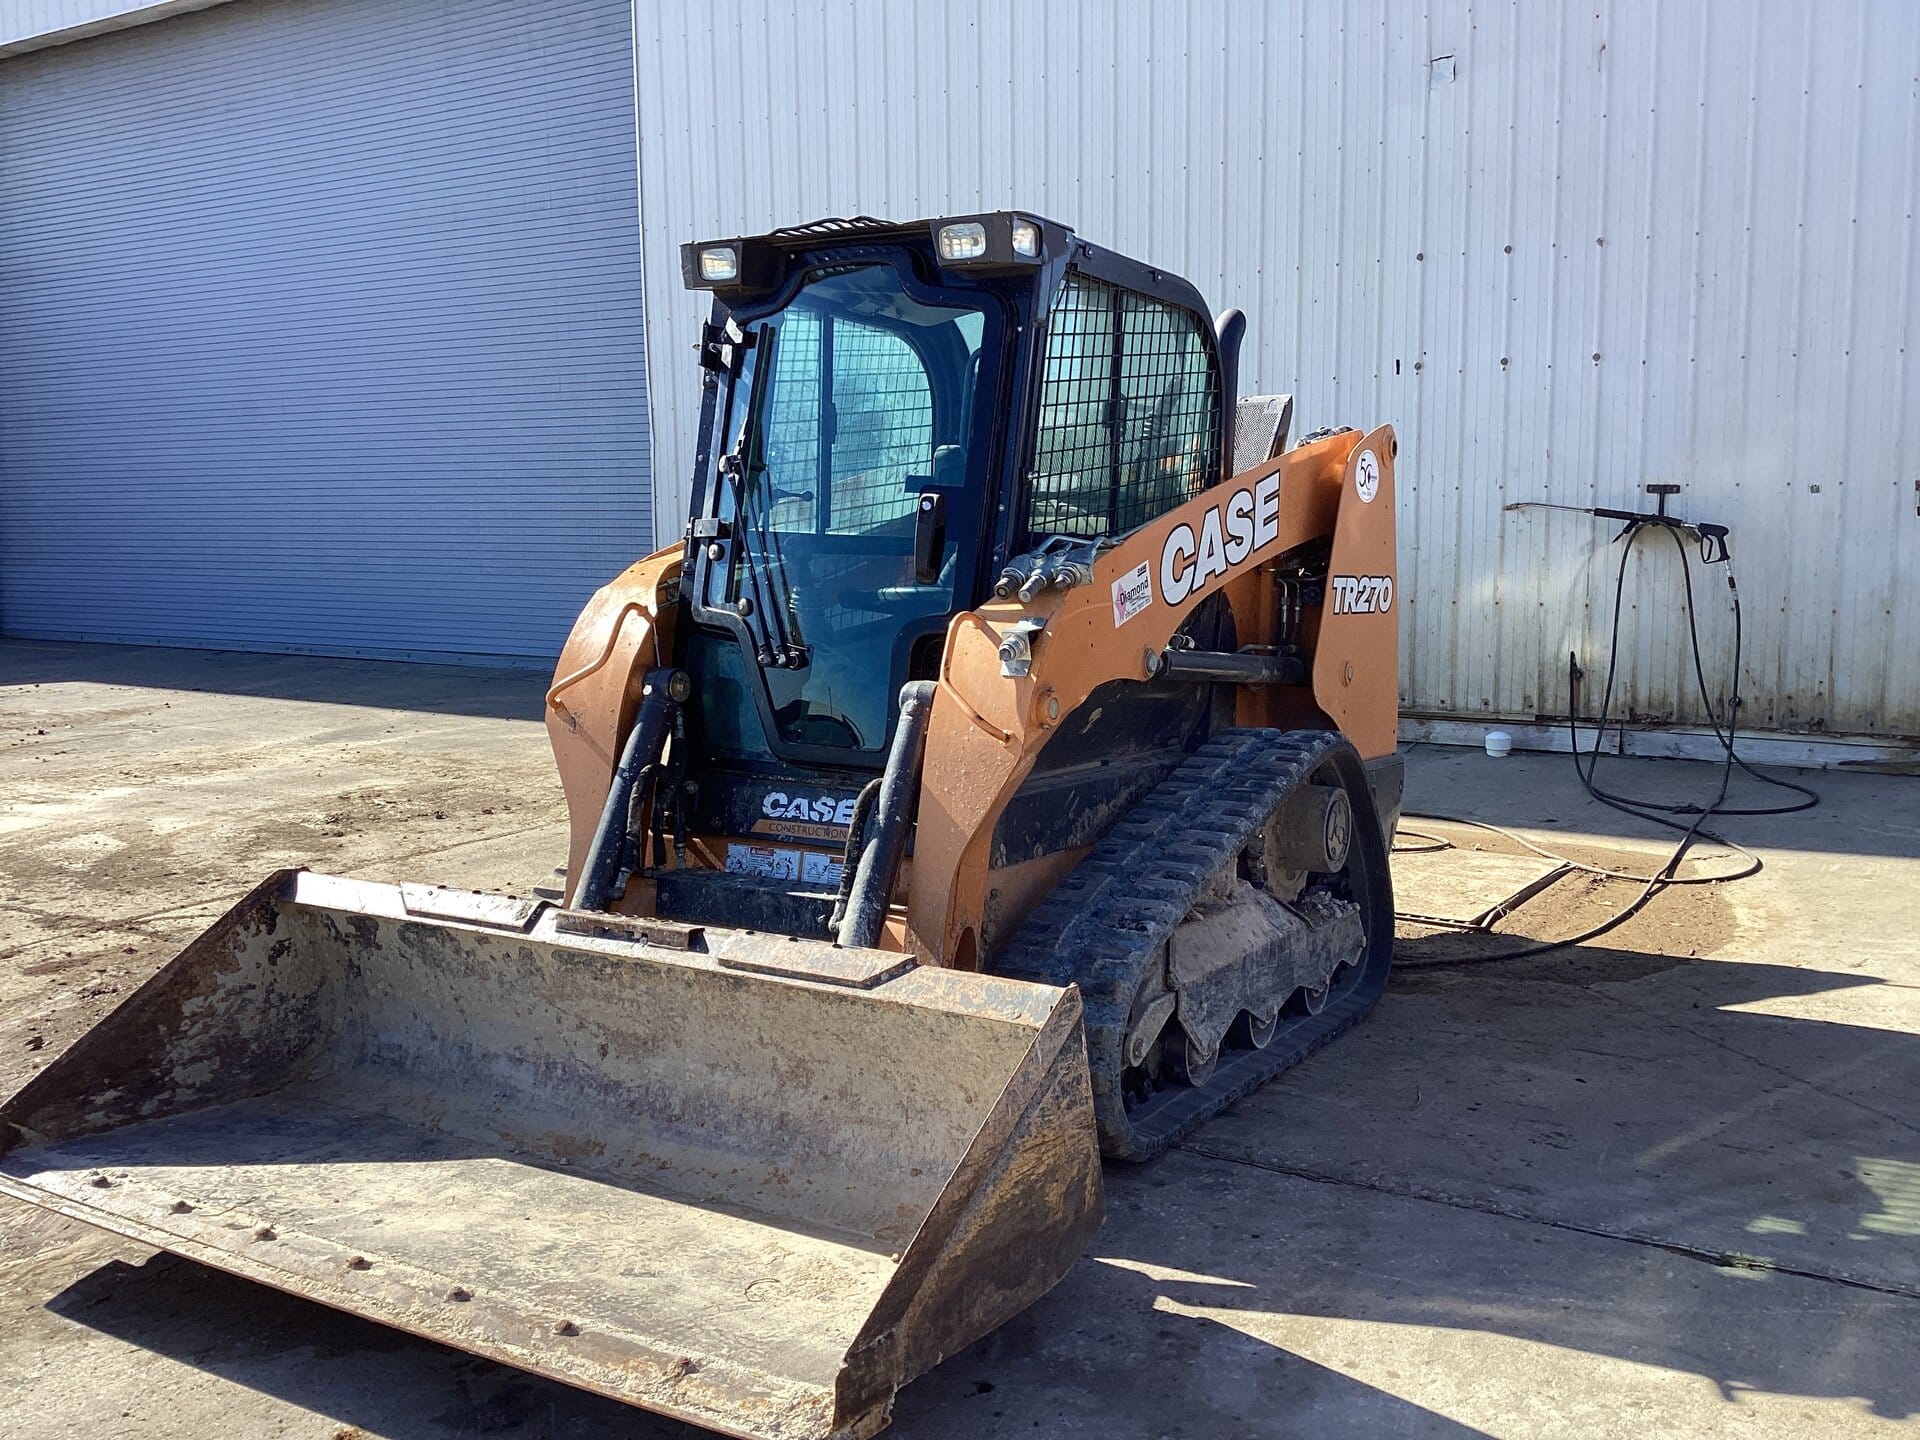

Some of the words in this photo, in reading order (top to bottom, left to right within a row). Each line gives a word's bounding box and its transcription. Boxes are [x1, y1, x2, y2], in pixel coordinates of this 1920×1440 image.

[1160, 468, 1280, 607] CASE
[1120, 576, 1149, 606] Diamond
[1333, 575, 1394, 615] TR270
[762, 792, 856, 824] CASE
